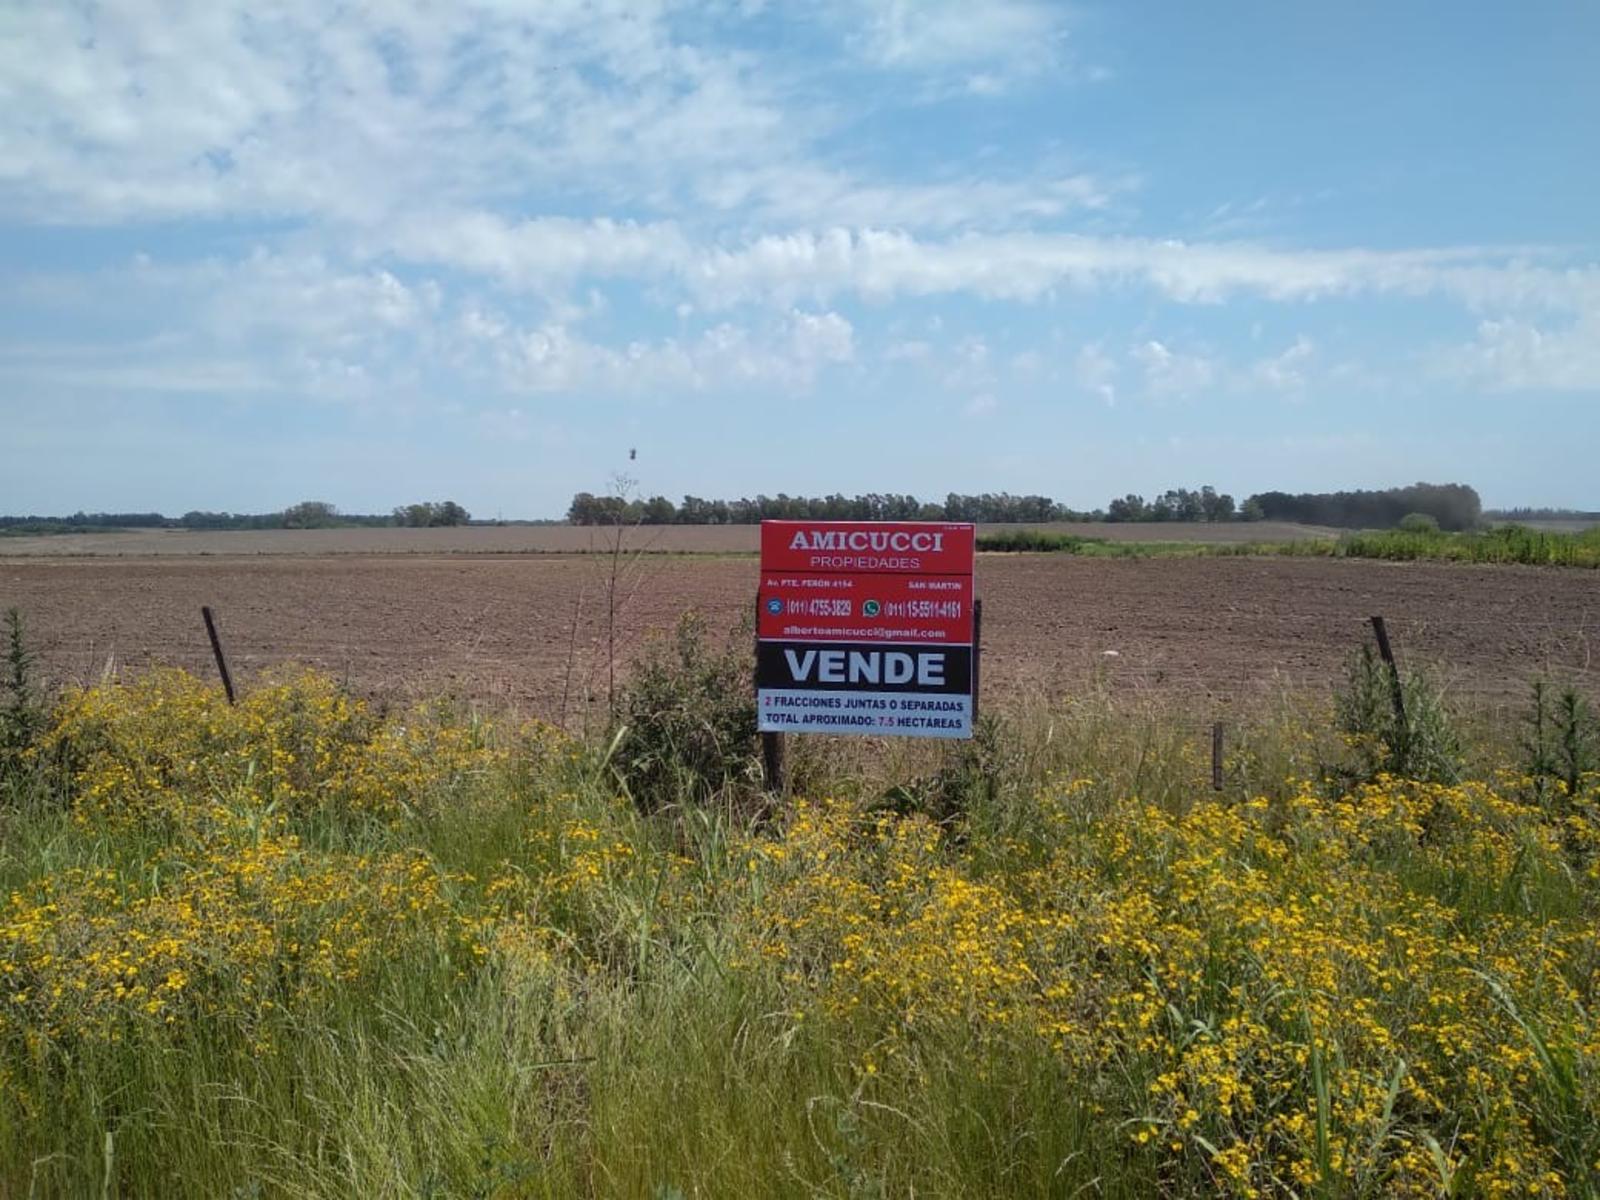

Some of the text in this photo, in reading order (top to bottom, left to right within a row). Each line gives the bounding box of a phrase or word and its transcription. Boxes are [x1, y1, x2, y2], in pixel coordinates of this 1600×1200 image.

[789, 531, 943, 551] AMICUCCI
[810, 556, 920, 569] PROPIEDADES
[908, 582, 926, 590] SAN
[784, 649, 945, 685] VENDE
[765, 696, 963, 711] 2 FRACCIONES JUNTAS O SEPARADAS
[766, 713, 799, 724] TOTAL
[802, 715, 875, 726] APROXIMADO:
